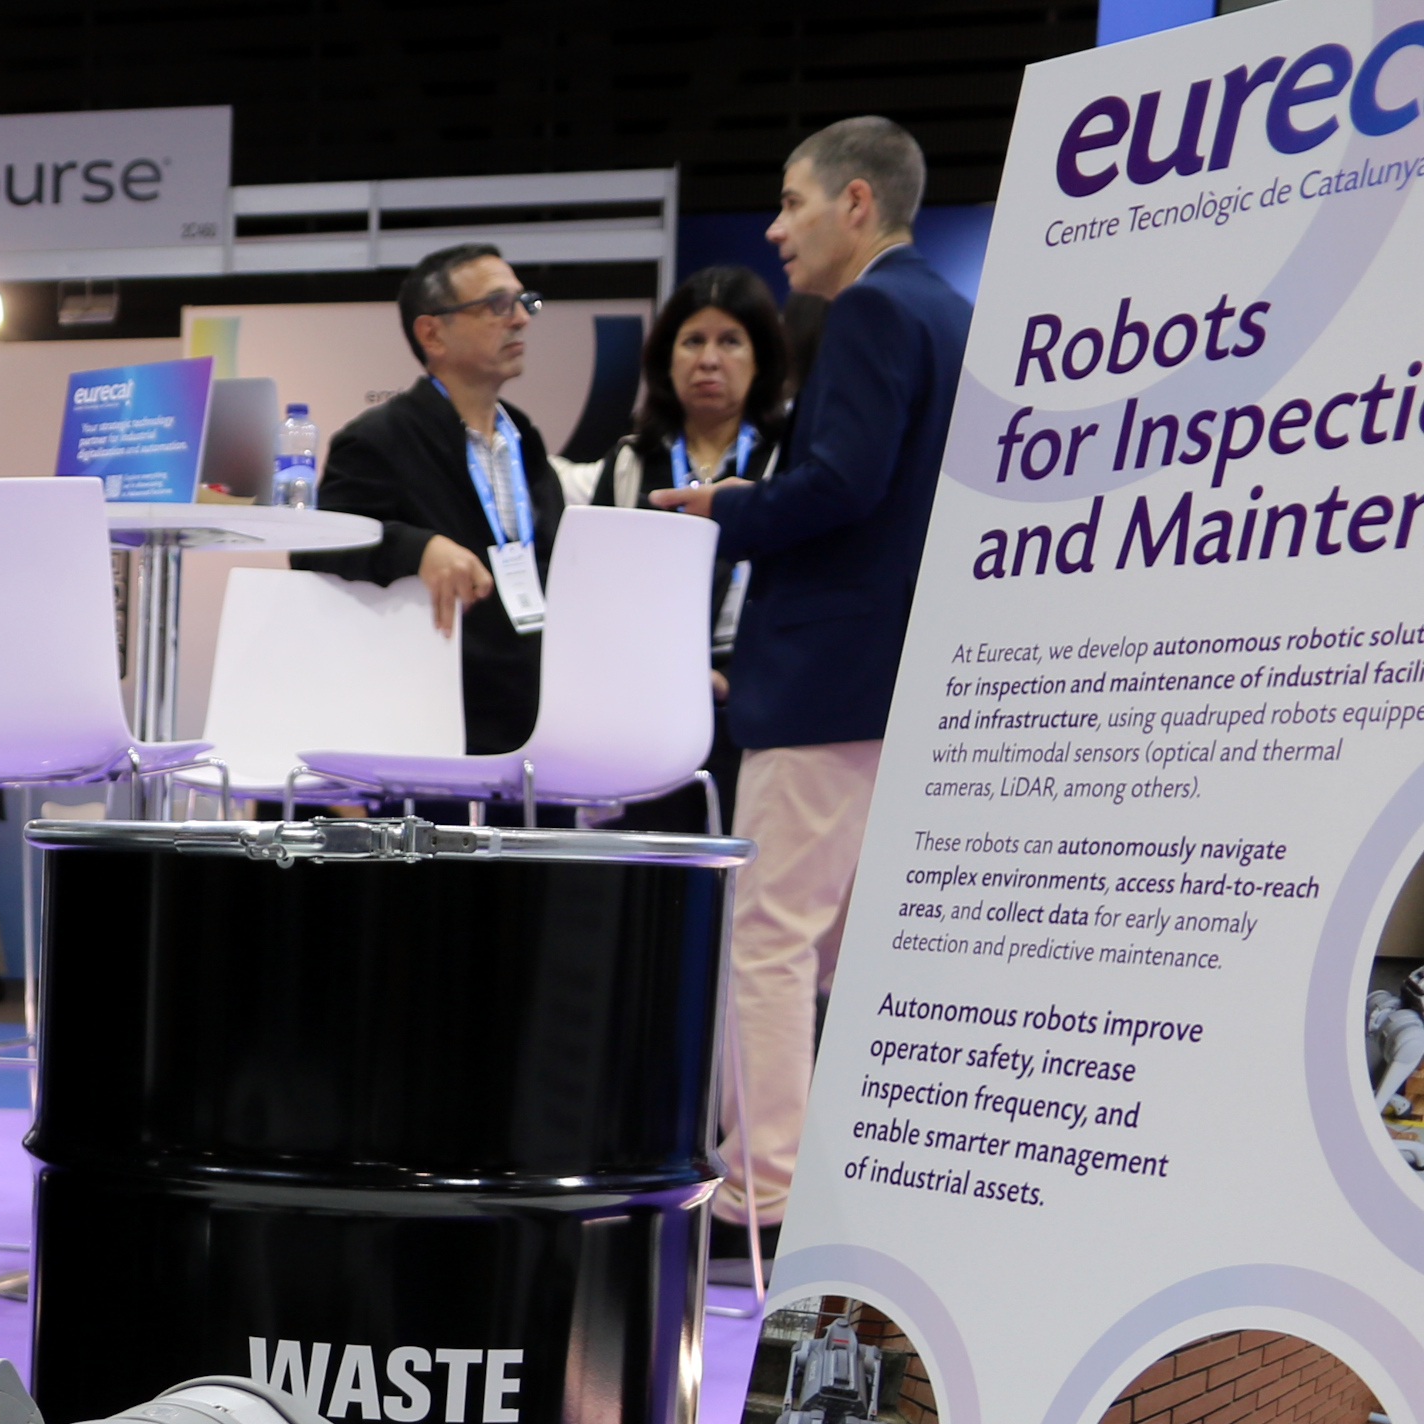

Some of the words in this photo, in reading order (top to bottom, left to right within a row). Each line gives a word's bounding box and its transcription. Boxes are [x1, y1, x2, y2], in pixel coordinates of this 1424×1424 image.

[1045, 218, 1119, 247] Centre
[1129, 191, 1253, 232] Tecnològic
[1260, 177, 1292, 207] de
[1015, 294, 1271, 386] Robots
[997, 407, 1099, 483] for
[1112, 361, 1424, 488] Inspecti
[973, 495, 1104, 580] and
[952, 644, 972, 663] At
[977, 643, 1042, 664] Eurecat,
[1049, 645, 1073, 659] we
[1078, 636, 1148, 663] develop
[1153, 636, 1281, 656] autonomous
[1287, 626, 1365, 650] robotic
[946, 676, 972, 696] for
[975, 675, 1066, 702] inspection
[1070, 672, 1106, 693] and
[1110, 672, 1235, 692] maintenance
[1240, 666, 1265, 688] of
[1267, 662, 1369, 687] industrial
[939, 709, 971, 729] and
[975, 709, 1100, 731] infrastructure,
[1108, 707, 1156, 734] using
[1161, 702, 1267, 733] quadruped
[1271, 701, 1337, 724] robots
[933, 743, 967, 762] with
[972, 741, 1071, 763] multimodal
[1074, 748, 1140, 762] sensors
[1146, 740, 1216, 769] (optical
[1220, 739, 1258, 762] and
[1263, 738, 1343, 761] thermal
[925, 782, 994, 800] cameras,
[1001, 777, 1057, 801] LiDAR,
[1064, 783, 1127, 805] among
[1131, 776, 1200, 798] others).
[915, 831, 961, 851] These
[965, 832, 1019, 853] robots
[1024, 840, 1053, 854] can
[1058, 836, 1196, 864] autonomously
[1201, 839, 1286, 866] navigate
[906, 865, 977, 891] complex
[982, 869, 1109, 895] environments,
[1115, 877, 1175, 893] access
[1180, 872, 1319, 898] hard-to-reach
[899, 903, 945, 922] areas,
[951, 900, 983, 920] and
[987, 901, 1044, 923] collect
[1049, 903, 1088, 925] data
[1095, 905, 1121, 927] for
[1126, 908, 1171, 936] early
[1175, 911, 1258, 941] anomaly
[892, 930, 968, 953] detection
[973, 935, 1006, 956] and
[1008, 938, 1094, 963] predictive
[1099, 944, 1221, 969] maintenance.
[878, 993, 1017, 1027] Autonomous
[1023, 1004, 1098, 1033] robots
[1104, 1011, 1203, 1046] improve
[871, 1040, 963, 1065] operator
[966, 1043, 1034, 1079] safety,
[1042, 1050, 1135, 1082] increase
[862, 1074, 968, 1108] inspection
[975, 1085, 1087, 1129] frequency,
[1095, 1102, 1141, 1128] and
[853, 1118, 920, 1145] enable
[924, 1130, 1010, 1156] smarter
[1015, 1142, 1169, 1177] management
[845, 1156, 869, 1179] of
[871, 1159, 970, 1194] industrial
[974, 1180, 1043, 1206] assets.
[249, 1335, 524, 1423] WASTE
